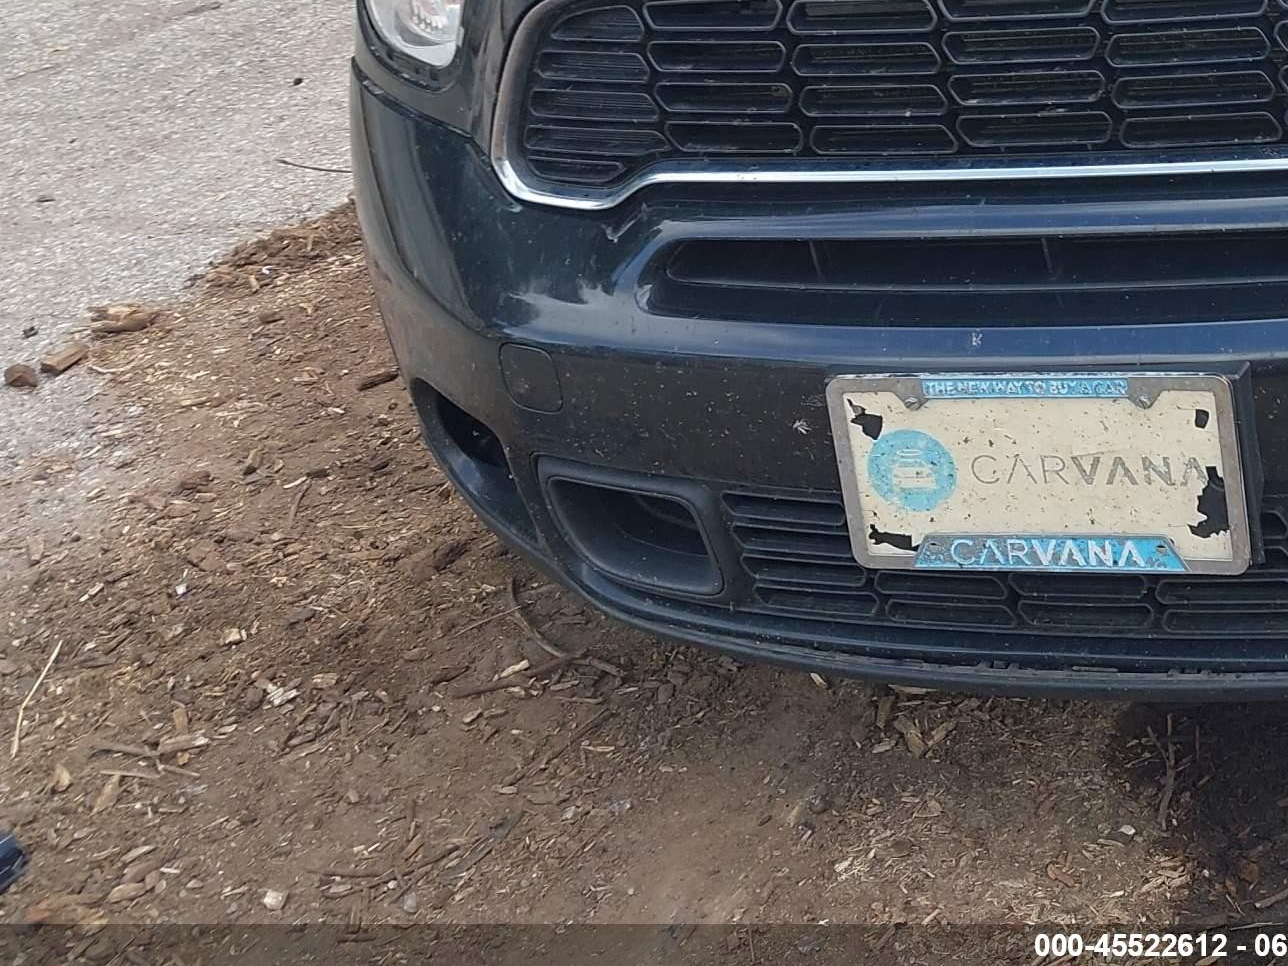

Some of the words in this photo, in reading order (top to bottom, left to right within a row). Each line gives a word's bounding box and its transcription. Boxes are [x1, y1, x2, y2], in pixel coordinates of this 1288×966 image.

[927, 380, 954, 395] THE
[992, 381, 1023, 395] WAY
[1024, 381, 1045, 395] TO
[1080, 382, 1093, 395] A
[1094, 381, 1129, 395] CAR
[971, 454, 1209, 487] CARVANA
[950, 538, 1146, 567] CARVANA
